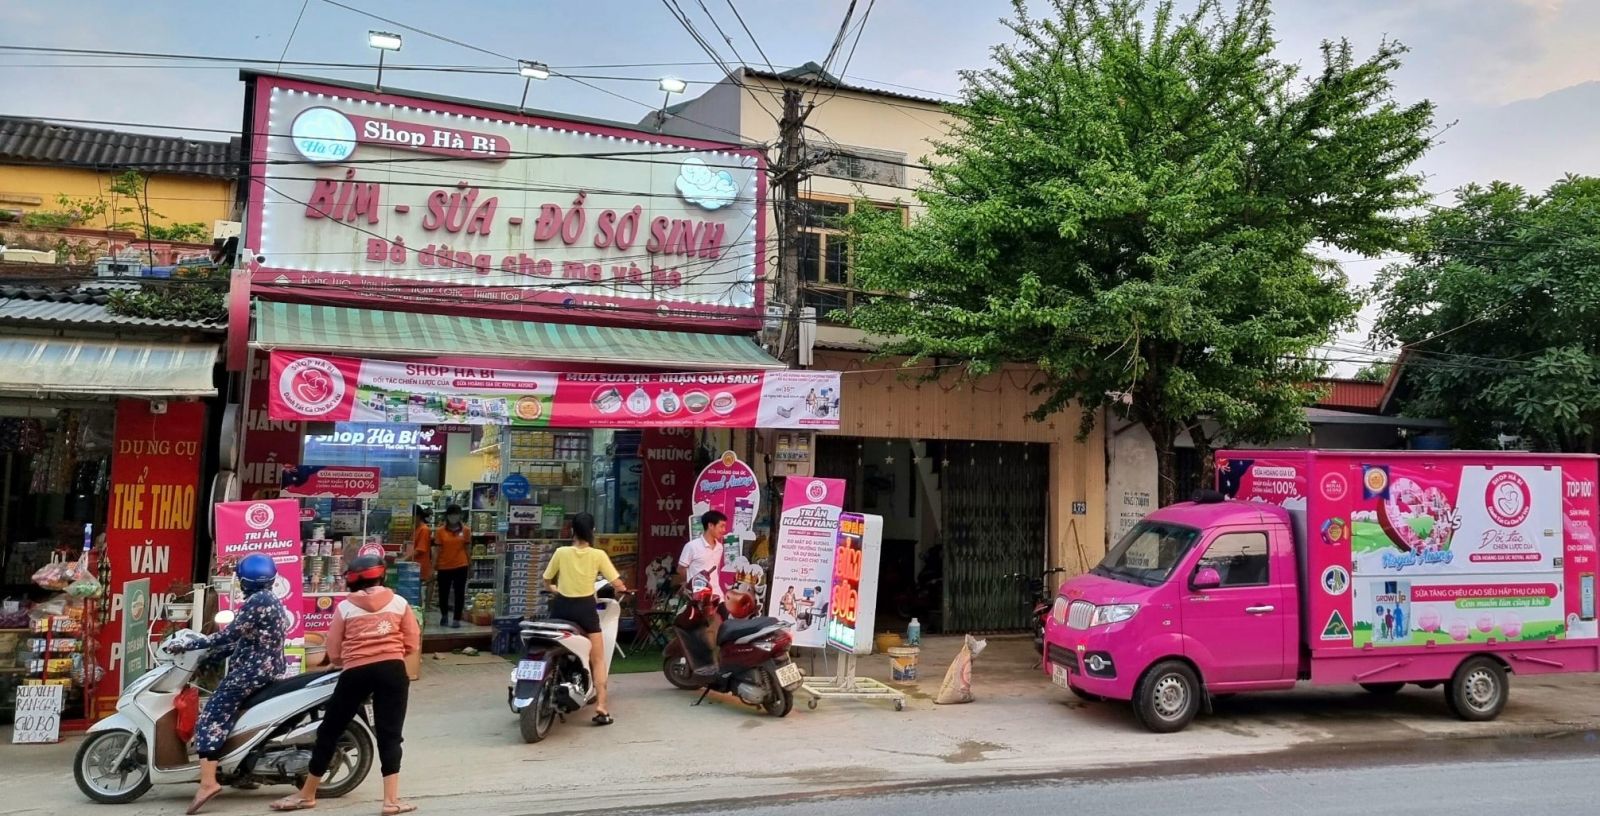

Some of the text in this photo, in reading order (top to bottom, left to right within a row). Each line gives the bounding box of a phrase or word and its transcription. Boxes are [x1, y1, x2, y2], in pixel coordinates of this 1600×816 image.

[364, 120, 497, 156] Shop Hà Bi
[305, 168, 380, 225] BỈM
[422, 181, 499, 236] SỮA
[534, 189, 586, 245] ĐỒ
[594, 204, 642, 251] SƠ
[647, 216, 725, 258] SINH
[367, 235, 407, 264] Đồ
[418, 244, 491, 275] dùng
[501, 253, 552, 276] cho
[406, 364, 449, 377] SHOP
[480, 369, 495, 379] BI
[566, 373, 596, 382] MUA
[660, 374, 696, 386] NHẬN
[727, 374, 759, 384] SANG
[367, 428, 395, 445] Hà
[120, 439, 198, 461] DỤNG CỤ
[344, 479, 375, 489] 100%
[1491, 473, 1508, 485] SHOP
[1272, 481, 1297, 495] 100%
[1567, 481, 1592, 497] TOP 100
[113, 465, 195, 530] THỂ THAO
[800, 507, 828, 518] TRI ÂN
[1073, 503, 1086, 513] 173
[783, 517, 838, 529] KHÁCH HÀNG
[244, 529, 278, 540] TRI ÂN
[225, 539, 293, 553] KHÁCH HÀNG
[130, 539, 170, 573] VĂN
[1415, 589, 1429, 598] SỮA
[1429, 588, 1447, 597] TĂNG
[1526, 587, 1546, 595] CANXI
[304, 621, 325, 629] DỊCH
